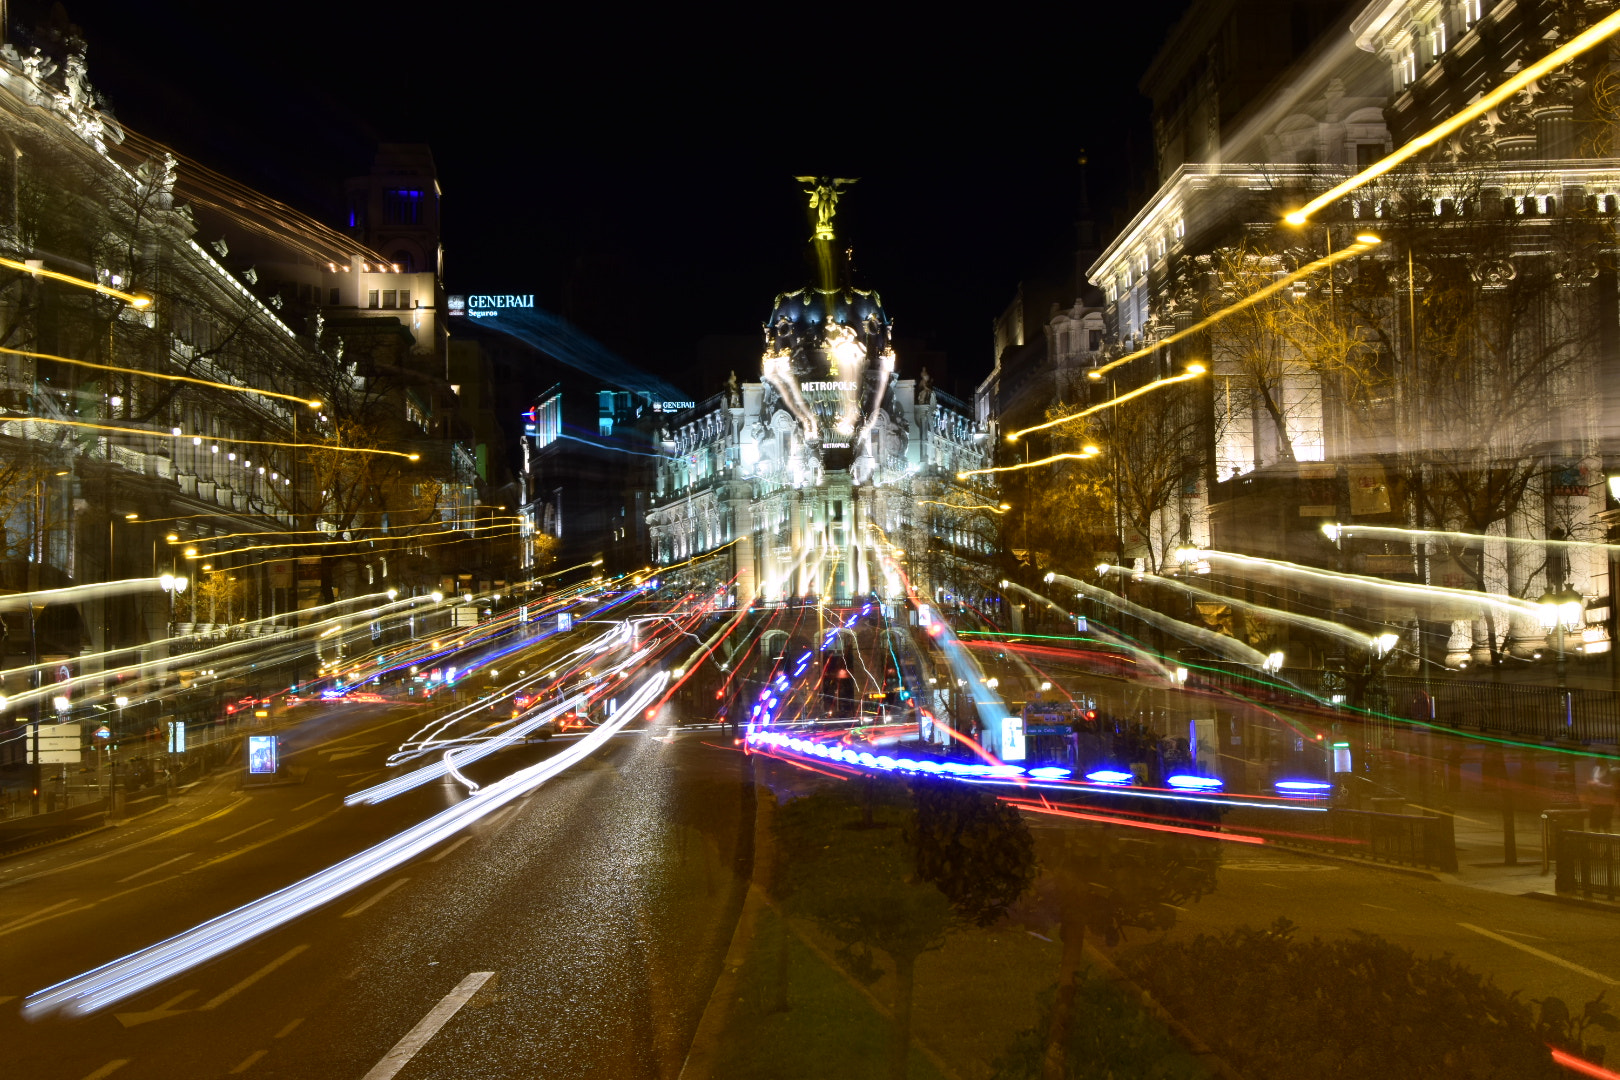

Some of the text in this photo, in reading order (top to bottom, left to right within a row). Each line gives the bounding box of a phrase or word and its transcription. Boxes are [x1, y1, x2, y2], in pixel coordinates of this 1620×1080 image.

[468, 295, 534, 308] GENERALI
[468, 309, 498, 318] Seguros
[801, 381, 857, 391] METROPOLIS
[663, 401, 695, 409] GENERALI
